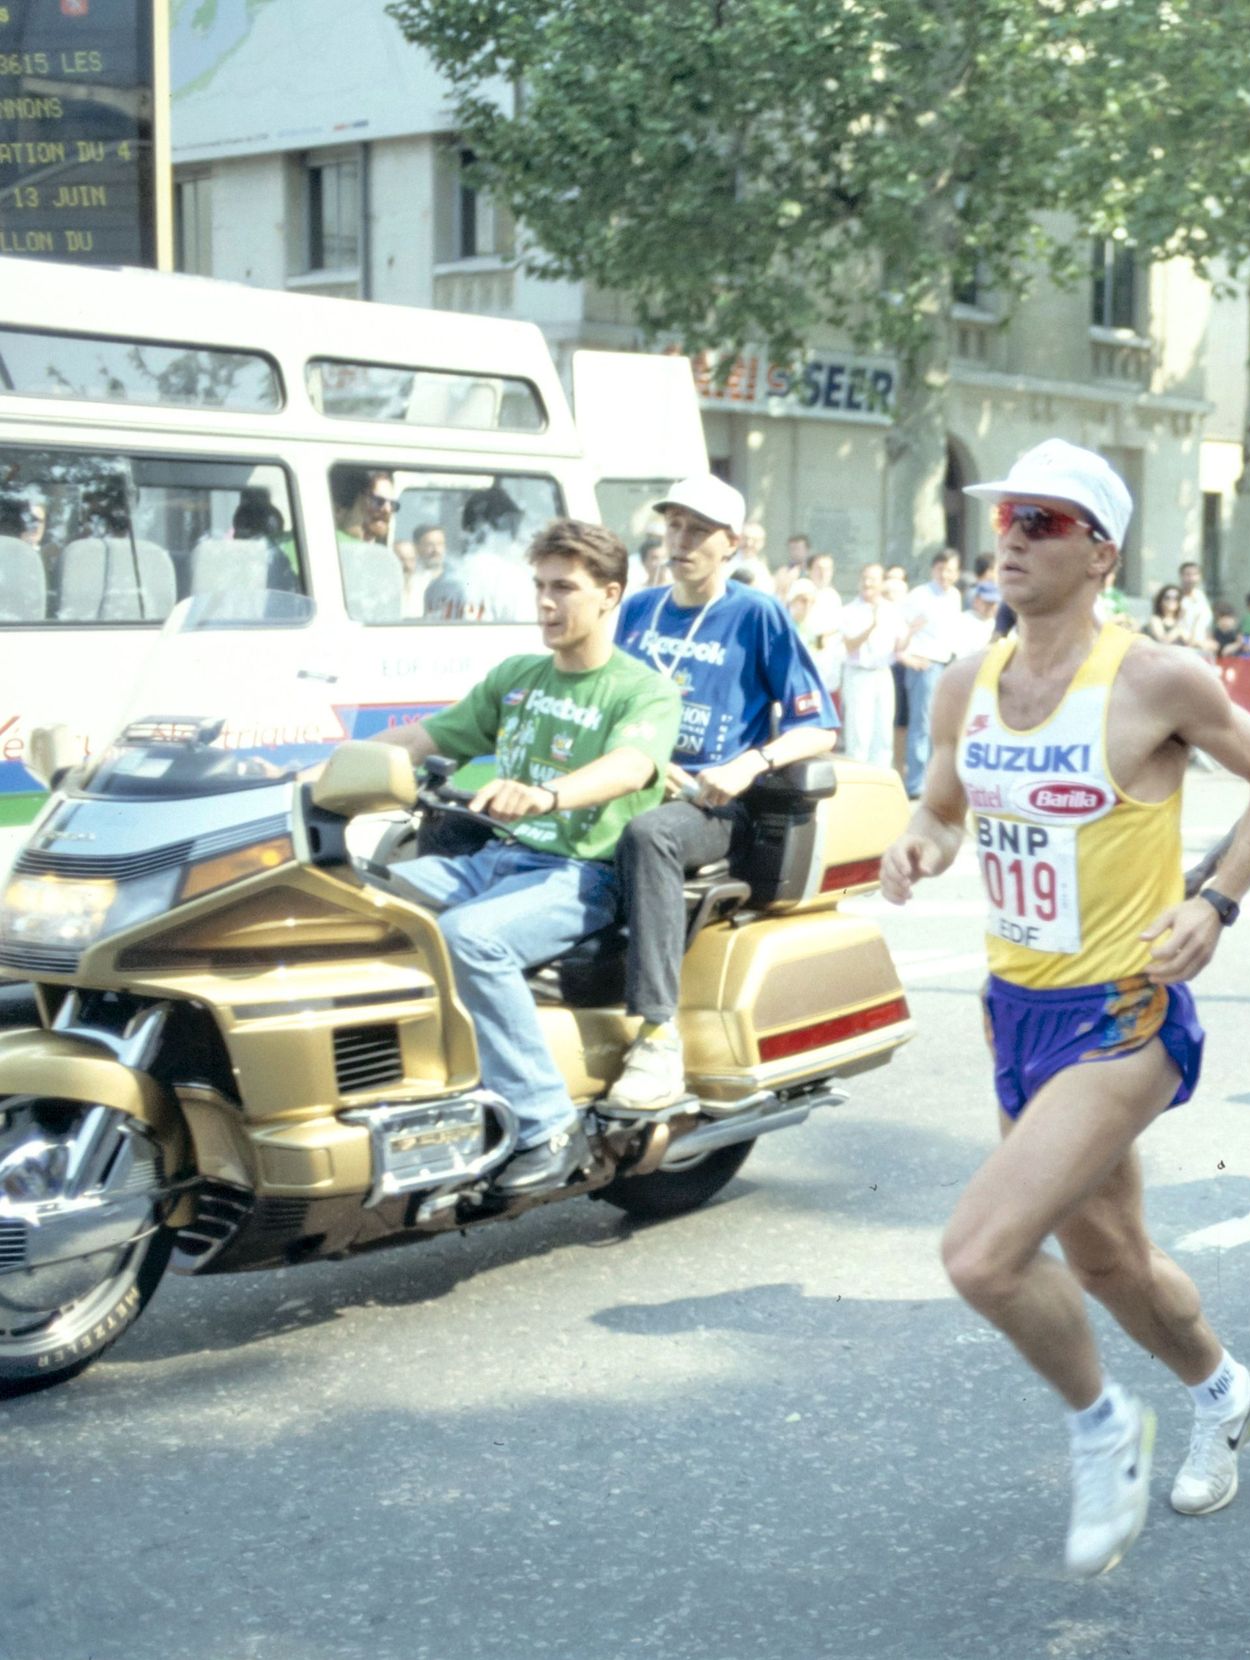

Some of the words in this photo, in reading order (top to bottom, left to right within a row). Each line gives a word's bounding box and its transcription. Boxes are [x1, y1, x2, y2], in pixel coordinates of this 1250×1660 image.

[61, 51, 103, 73] LES
[0, 142, 65, 164] ATION
[77, 141, 104, 162] DU
[117, 141, 132, 161] 4
[14, 187, 39, 208] 13
[53, 186, 106, 207] JUIN
[65, 231, 93, 251] DU
[965, 741, 1092, 772] SUZUKI
[1035, 790, 1099, 809] Barilla
[977, 816, 1049, 856] BNP
[984, 850, 1057, 921] 019
[1001, 919, 1040, 945] EDF
